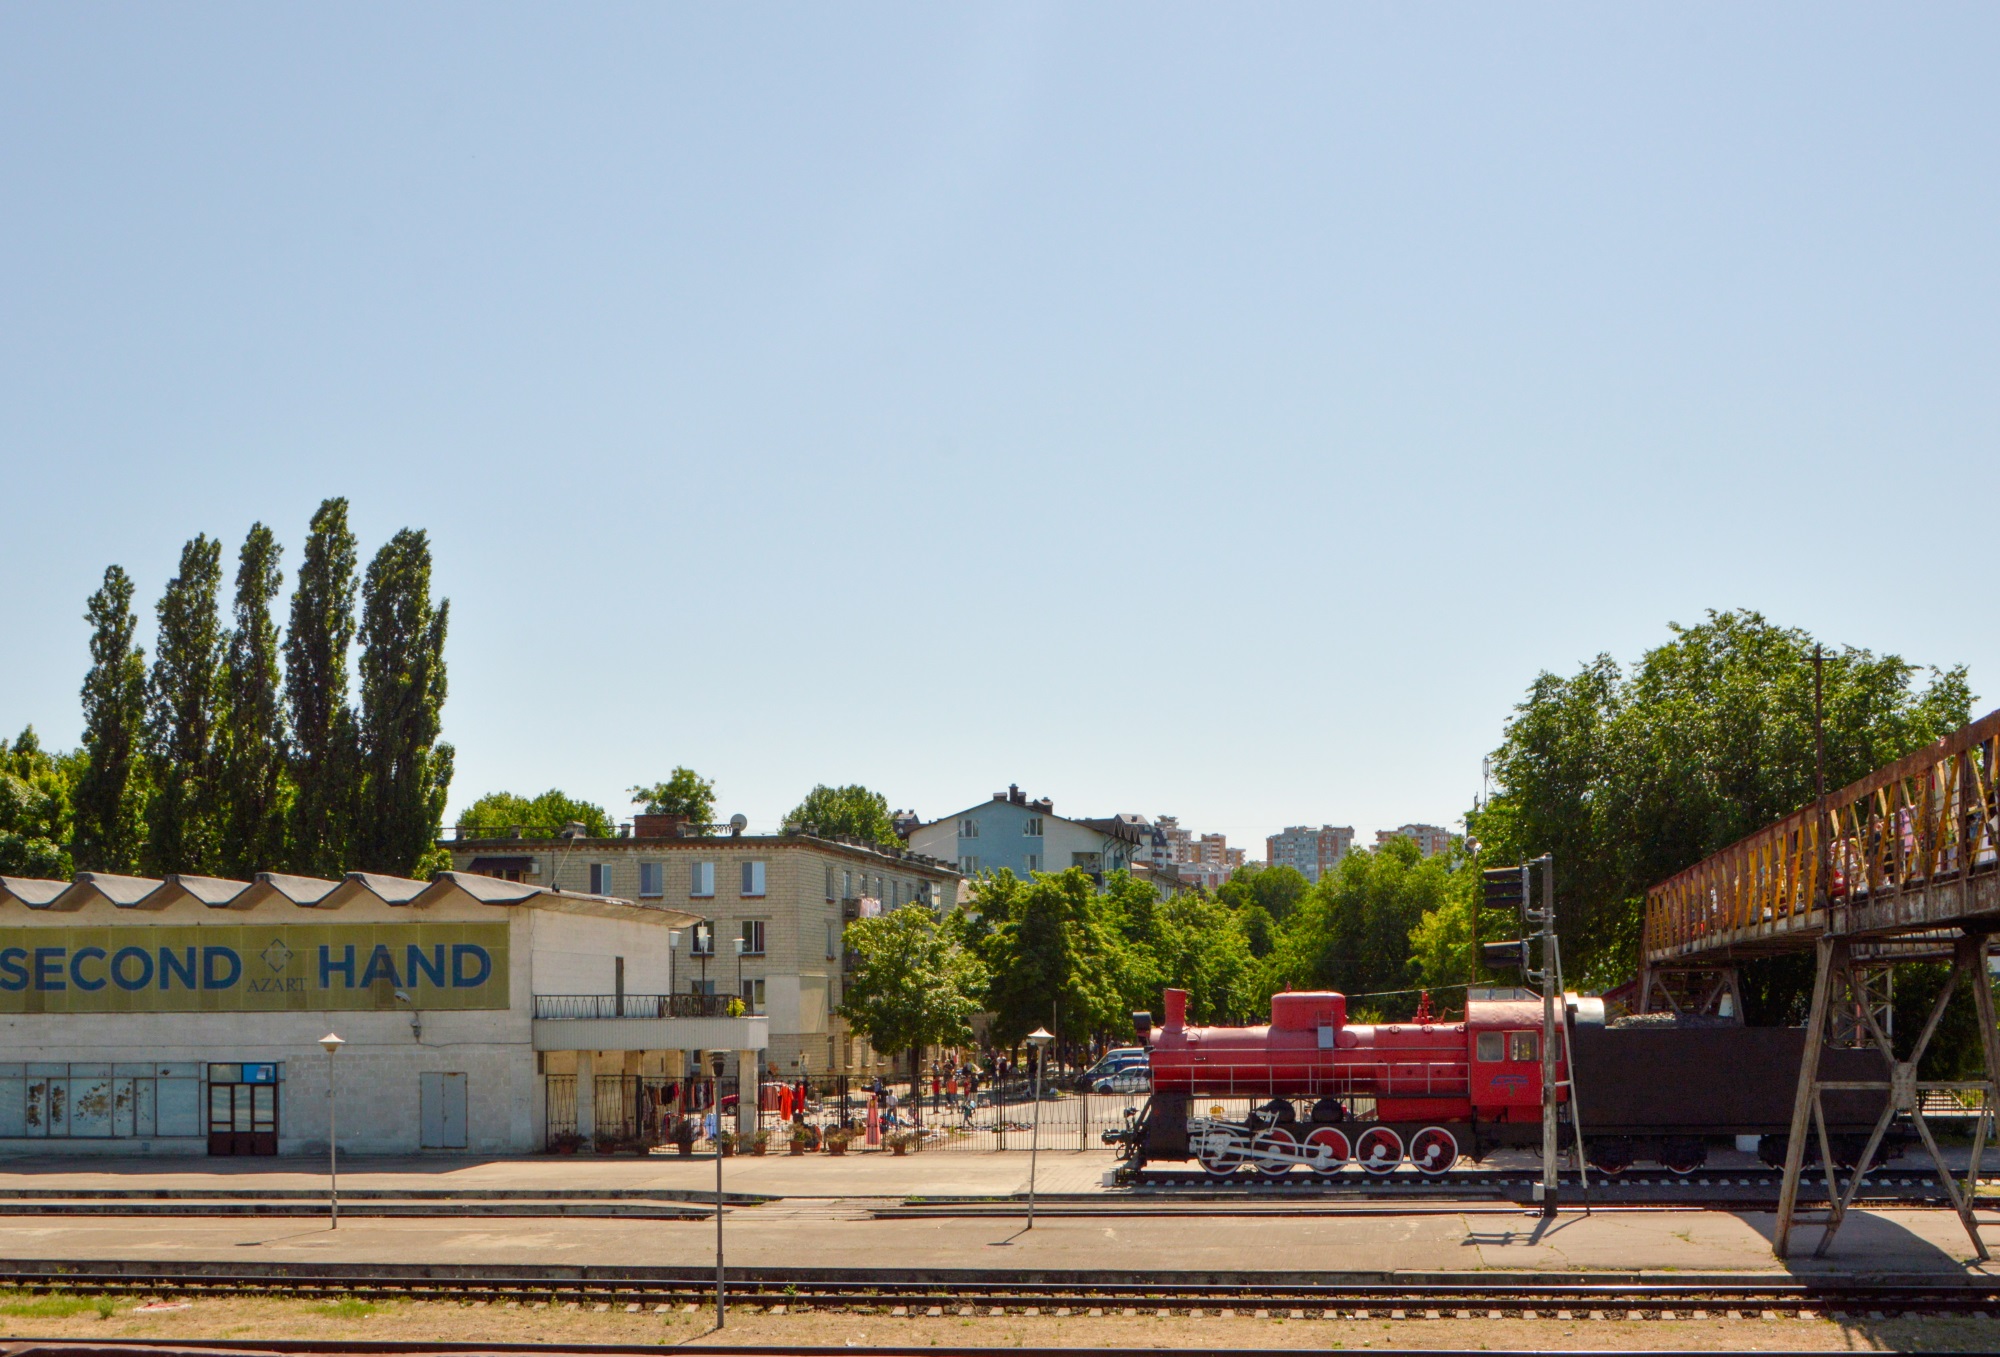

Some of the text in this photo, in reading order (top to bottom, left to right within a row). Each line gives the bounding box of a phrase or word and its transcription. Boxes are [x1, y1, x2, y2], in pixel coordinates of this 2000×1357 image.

[0, 944, 492, 991] SECOND HAND
[247, 977, 307, 993] AZART
